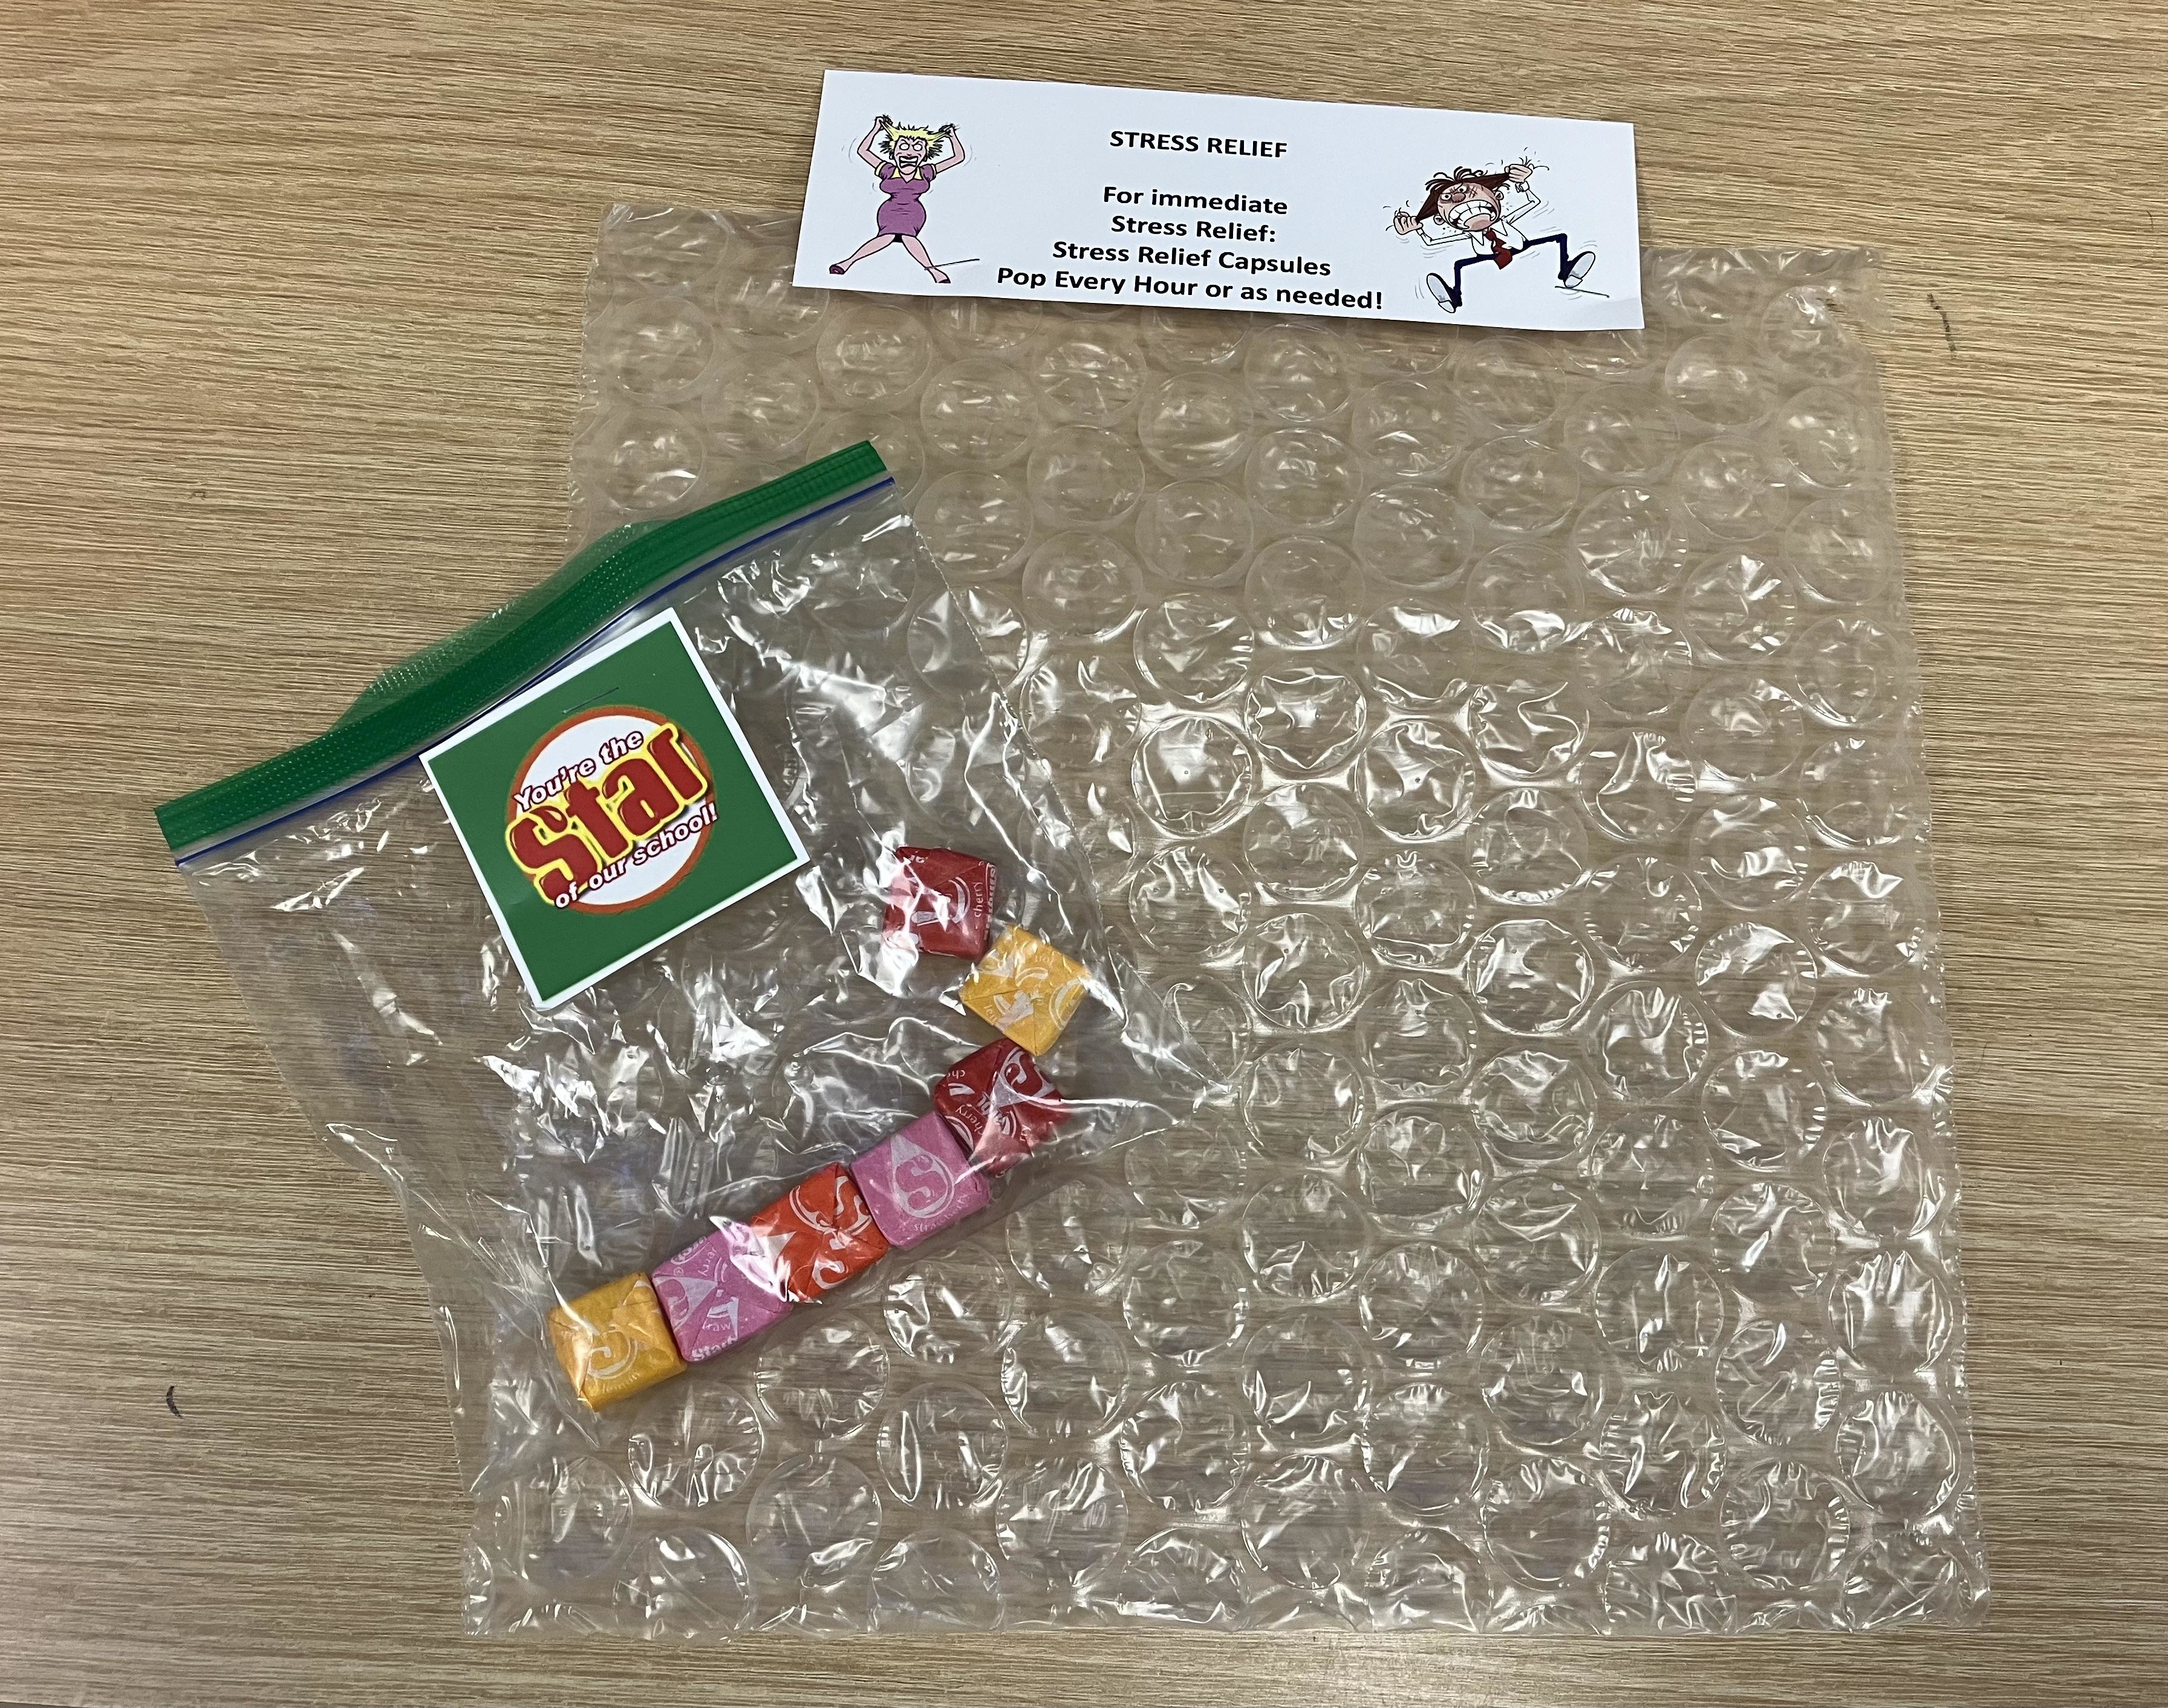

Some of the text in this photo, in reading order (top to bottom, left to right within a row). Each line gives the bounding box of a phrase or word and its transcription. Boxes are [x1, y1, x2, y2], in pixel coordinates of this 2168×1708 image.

[1110, 131, 1287, 158] STRESS RELIEF
[1104, 186, 1287, 215] For immediate
[1111, 215, 1275, 242] Stress Relief:
[1052, 241, 1331, 276] Stress Relief Capsules
[997, 267, 1382, 310] Pop Every Hour or as needed!
[513, 730, 643, 812] You're the
[506, 723, 708, 904] Star
[554, 802, 718, 909] of our school!
[974, 882, 983, 918] cherry
